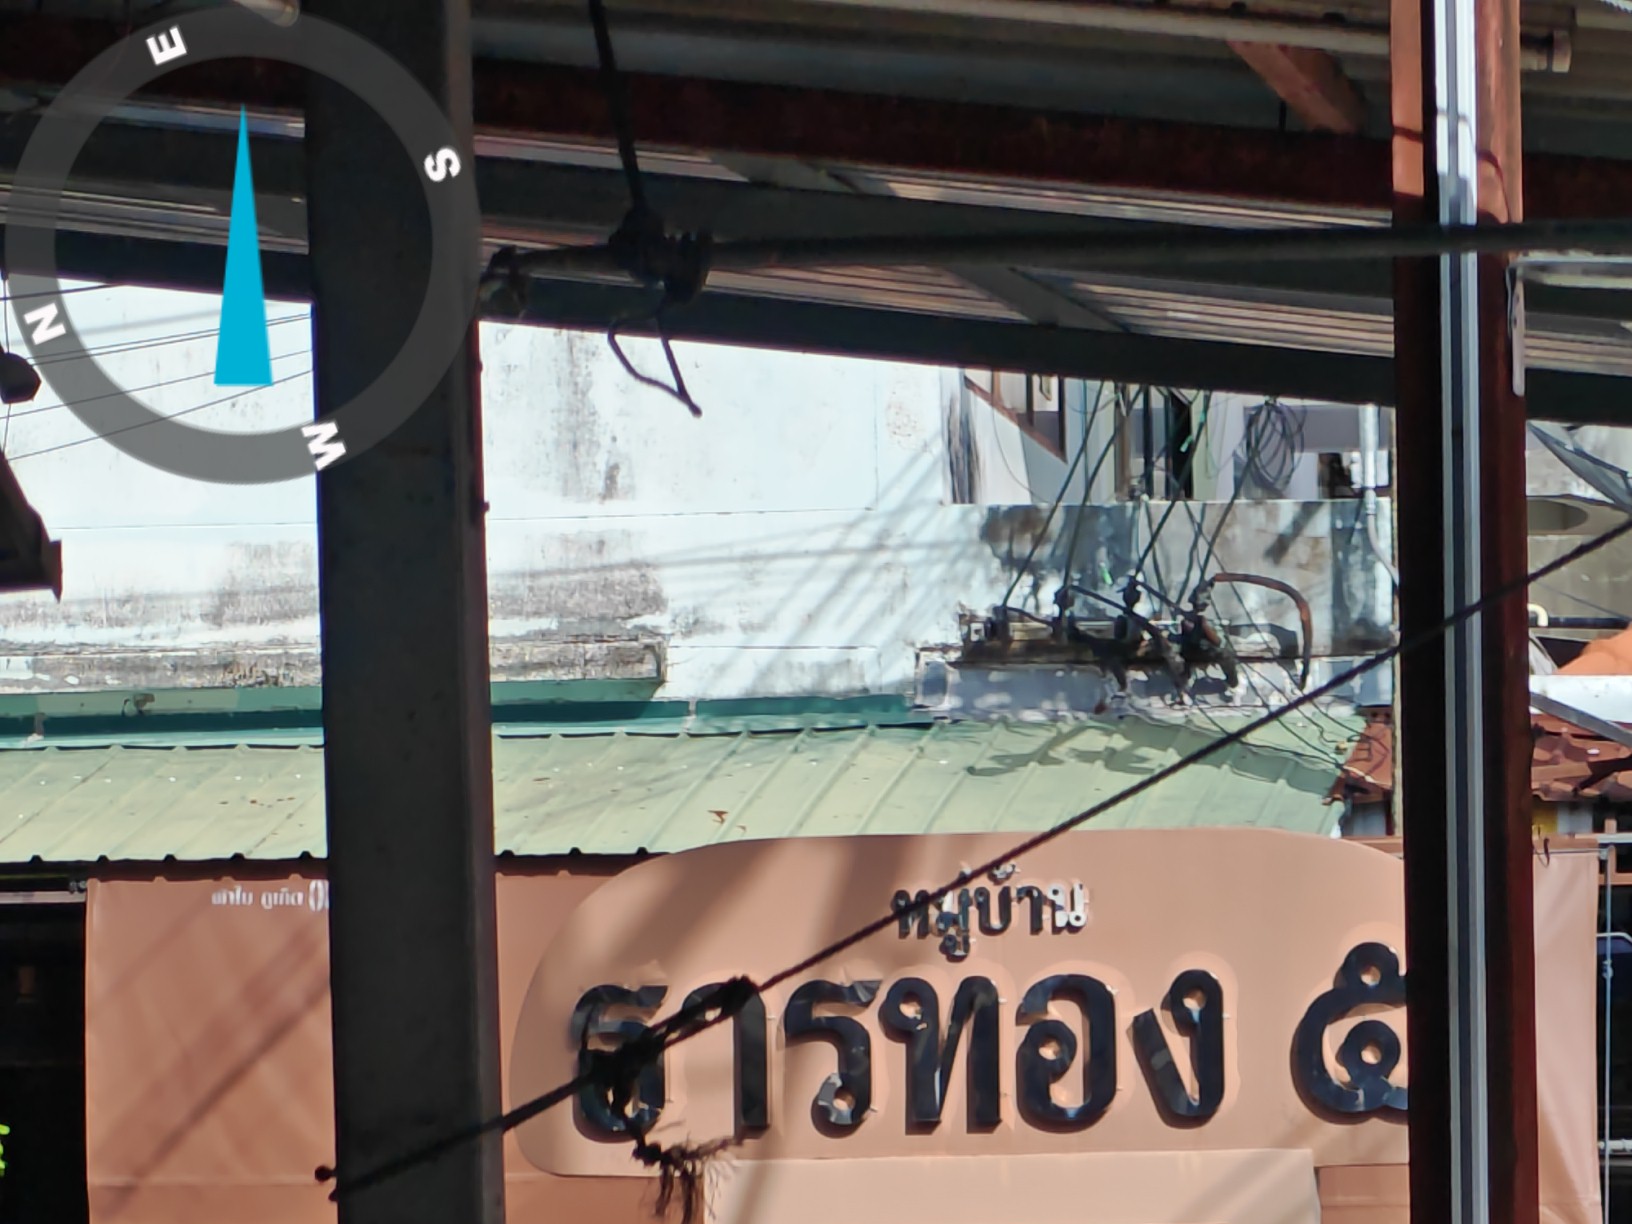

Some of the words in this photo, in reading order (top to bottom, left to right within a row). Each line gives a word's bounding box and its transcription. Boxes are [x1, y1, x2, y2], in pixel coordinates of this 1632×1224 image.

[889, 863, 1089, 959] หมู่บ้าน
[569, 964, 1229, 1141] ธารทอง
